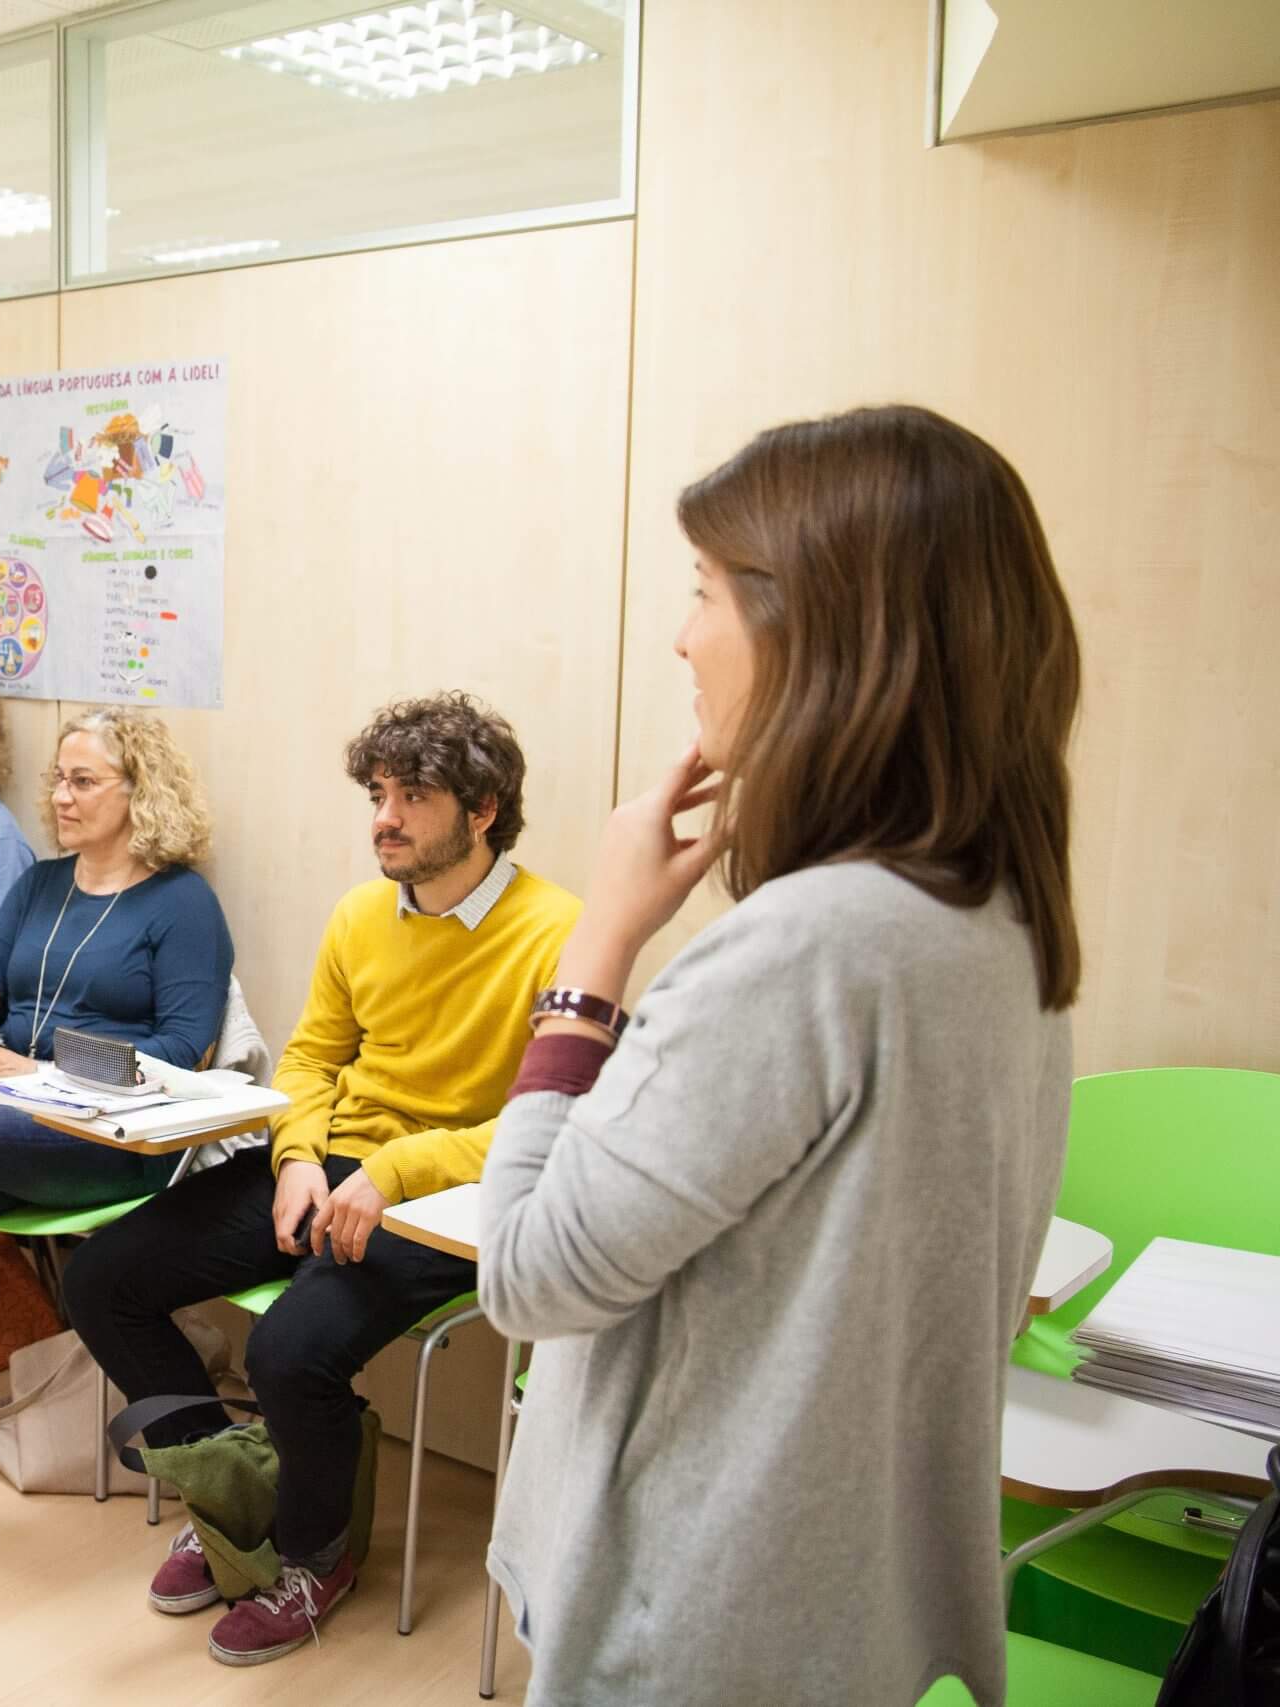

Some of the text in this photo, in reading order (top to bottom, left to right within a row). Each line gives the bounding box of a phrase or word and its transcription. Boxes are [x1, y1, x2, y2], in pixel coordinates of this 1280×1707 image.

[0, 383, 13, 398] DA
[16, 377, 54, 396] LÍNGUA
[58, 371, 132, 391] PORTUGUESA
[137, 368, 163, 385] COM
[167, 367, 177, 382] A
[182, 364, 220, 382] LIDEL!
